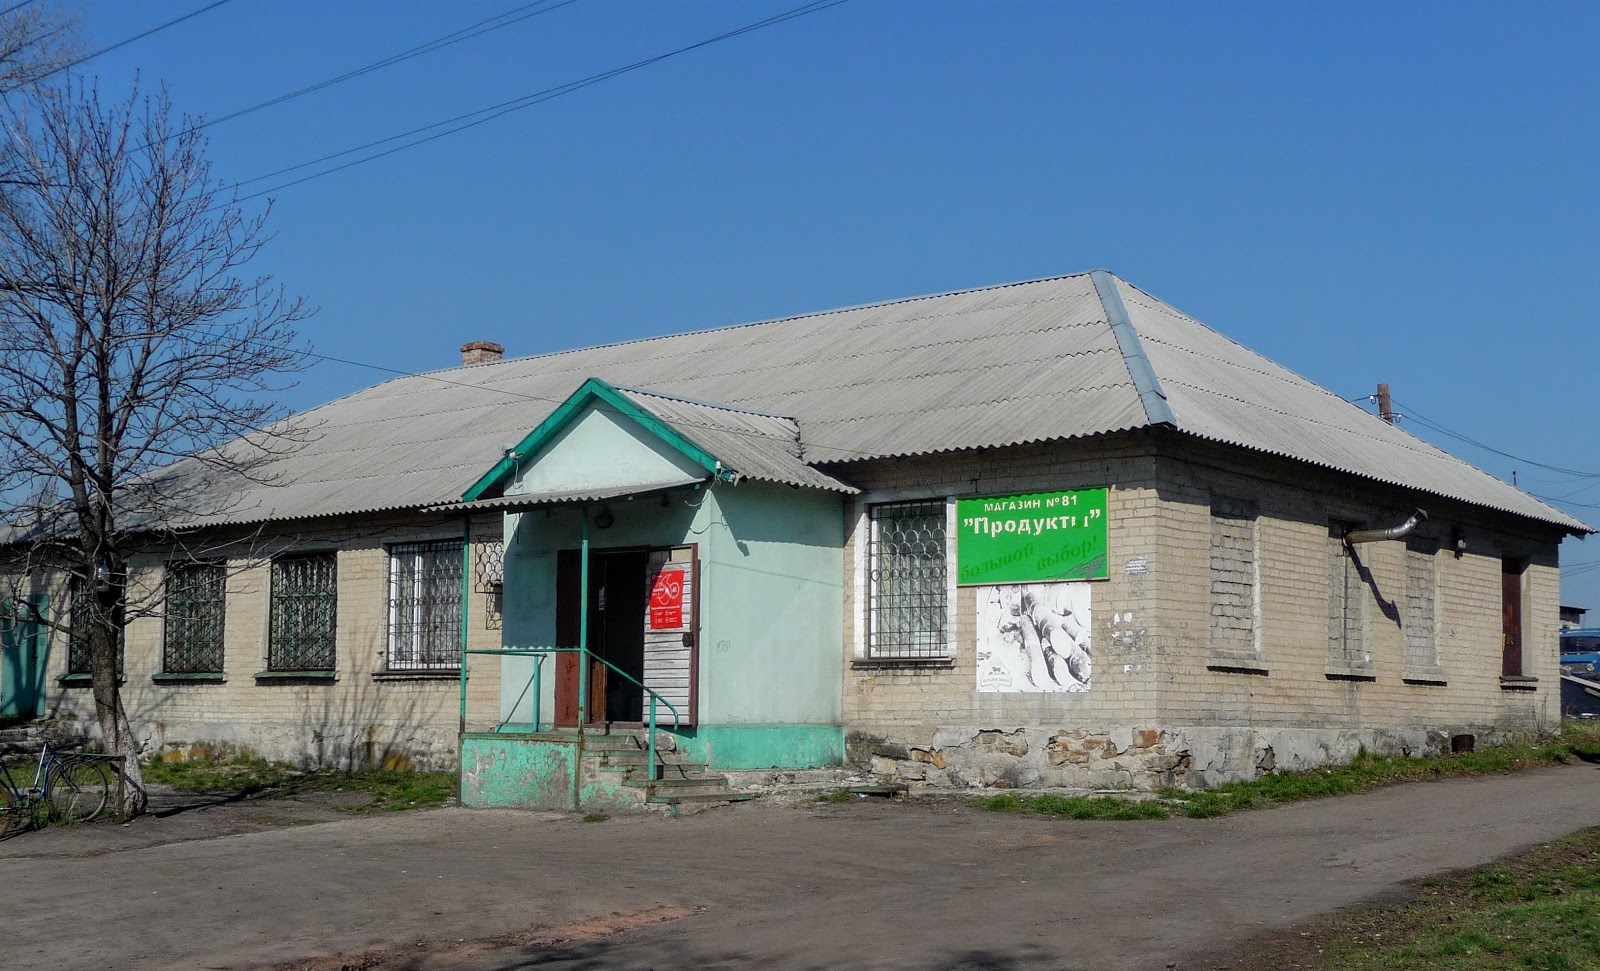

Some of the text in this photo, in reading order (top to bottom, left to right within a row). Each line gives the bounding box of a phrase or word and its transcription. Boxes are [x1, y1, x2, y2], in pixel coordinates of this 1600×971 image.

[984, 499, 1041, 512] МАГАЗИН
[961, 542, 1035, 581] большой
[1036, 536, 1097, 571] выбор!
